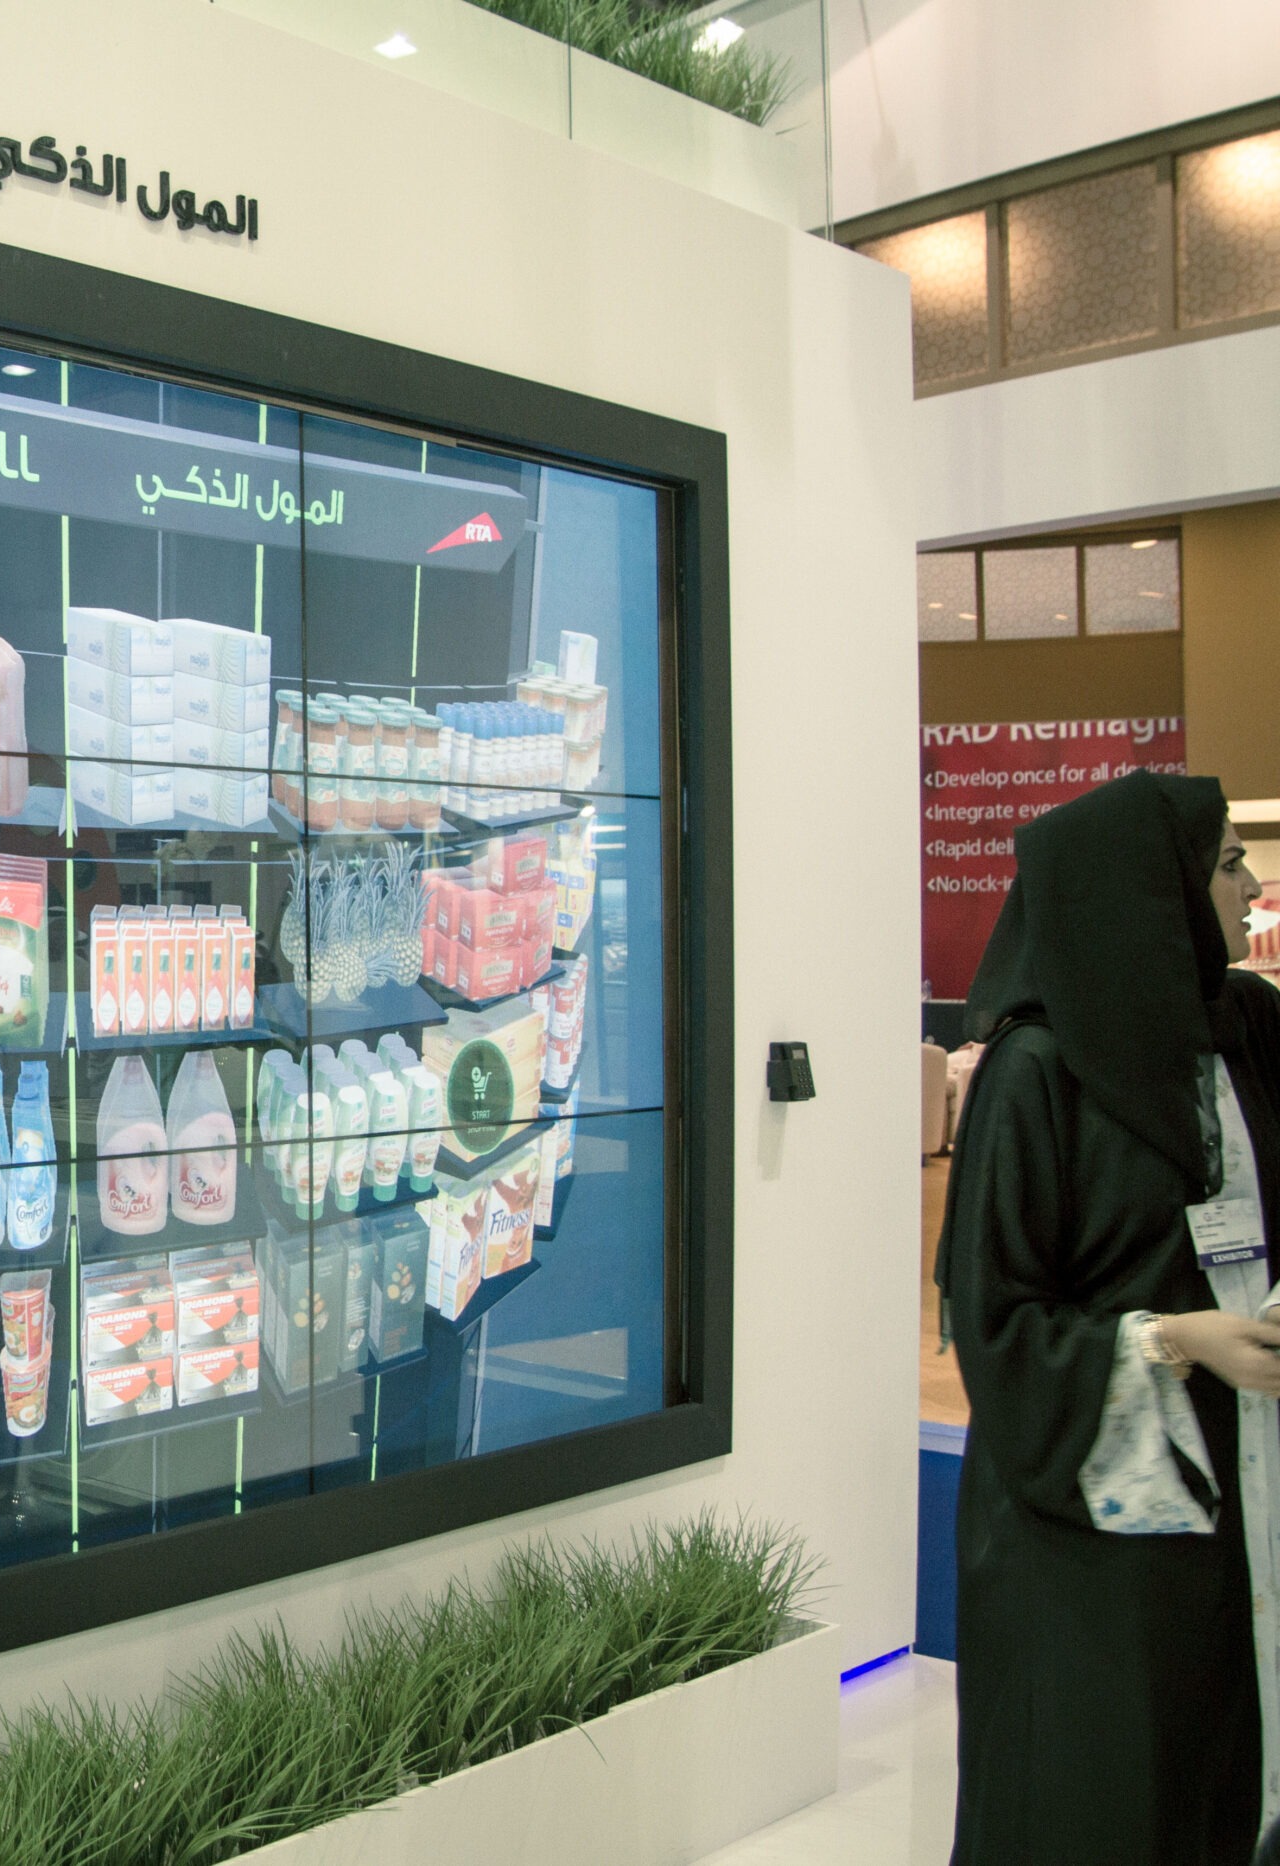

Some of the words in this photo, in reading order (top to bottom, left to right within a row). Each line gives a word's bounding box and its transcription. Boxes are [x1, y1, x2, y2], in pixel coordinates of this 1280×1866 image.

[137, 171, 258, 240] المول
[135, 465, 249, 516] الذكي
[255, 479, 344, 526] المول
[464, 521, 493, 542] RTA
[935, 767, 1009, 790] Develop
[1012, 769, 1056, 784] once
[1060, 763, 1086, 783] for
[1091, 761, 1109, 782] all
[934, 804, 1014, 825] Integrate
[934, 838, 982, 862] Rapid
[108, 1189, 151, 1220] Comfort
[178, 1180, 222, 1209] Comfort
[16, 1199, 49, 1224] Comfort
[490, 1209, 530, 1236] Fitness
